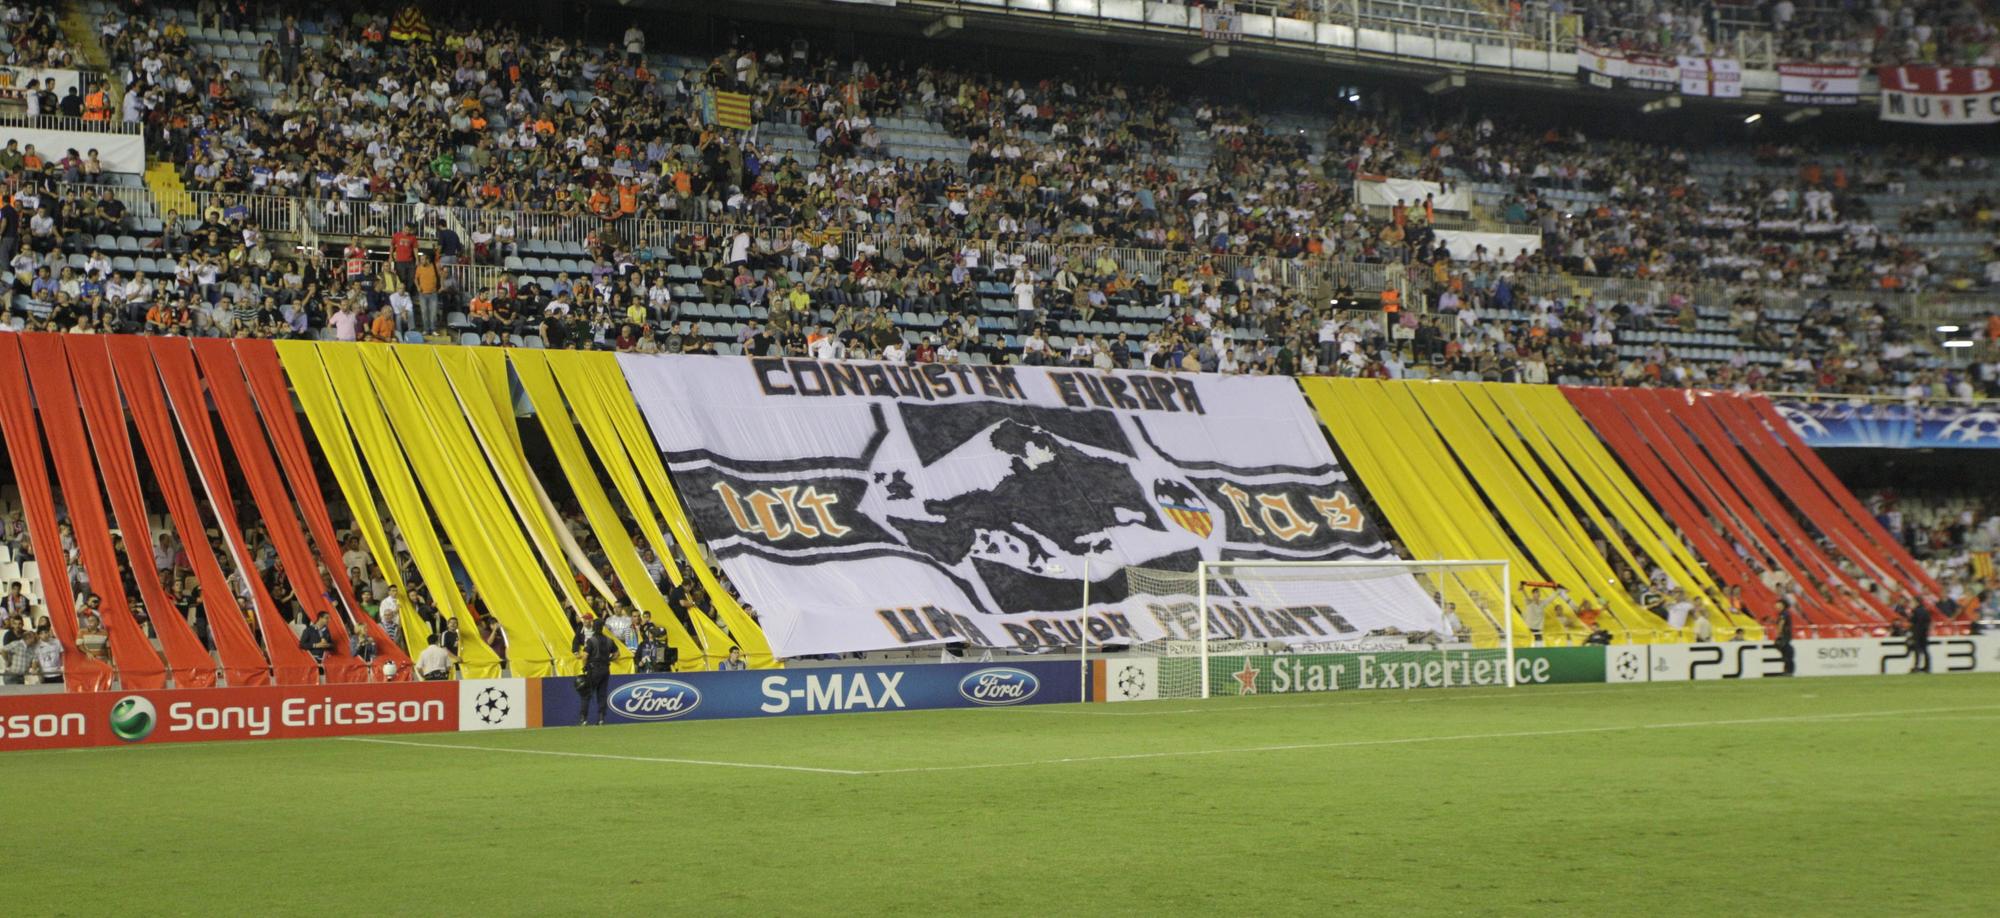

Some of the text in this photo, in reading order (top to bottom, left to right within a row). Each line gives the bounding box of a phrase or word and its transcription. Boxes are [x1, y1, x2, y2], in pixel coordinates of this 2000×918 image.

[752, 357, 1028, 401] CONQUISTEM
[1817, 647, 1861, 659] SONY
[974, 673, 1024, 698] Ford
[1272, 652, 1550, 692] Star Experience
[625, 685, 684, 713] Ford
[760, 671, 905, 713] S-MAX
[0, 713, 86, 739] sson
[169, 697, 445, 736] Sony Ericsson
